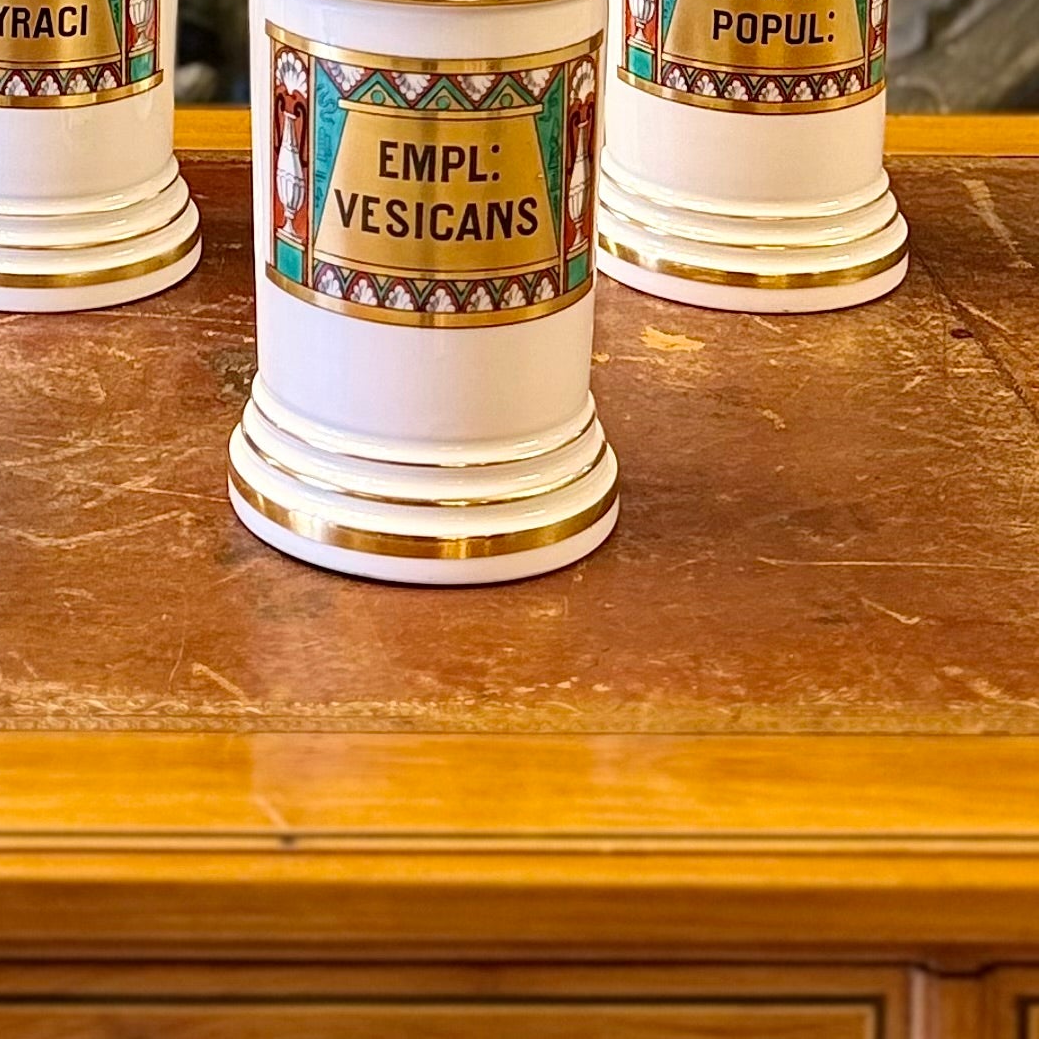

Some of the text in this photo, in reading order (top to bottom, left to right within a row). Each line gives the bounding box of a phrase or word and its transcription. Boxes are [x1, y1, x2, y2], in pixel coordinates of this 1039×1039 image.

[712, 8, 835, 45] POPUL:
[378, 139, 500, 183] EMPL:
[333, 188, 538, 242] VESICANS
